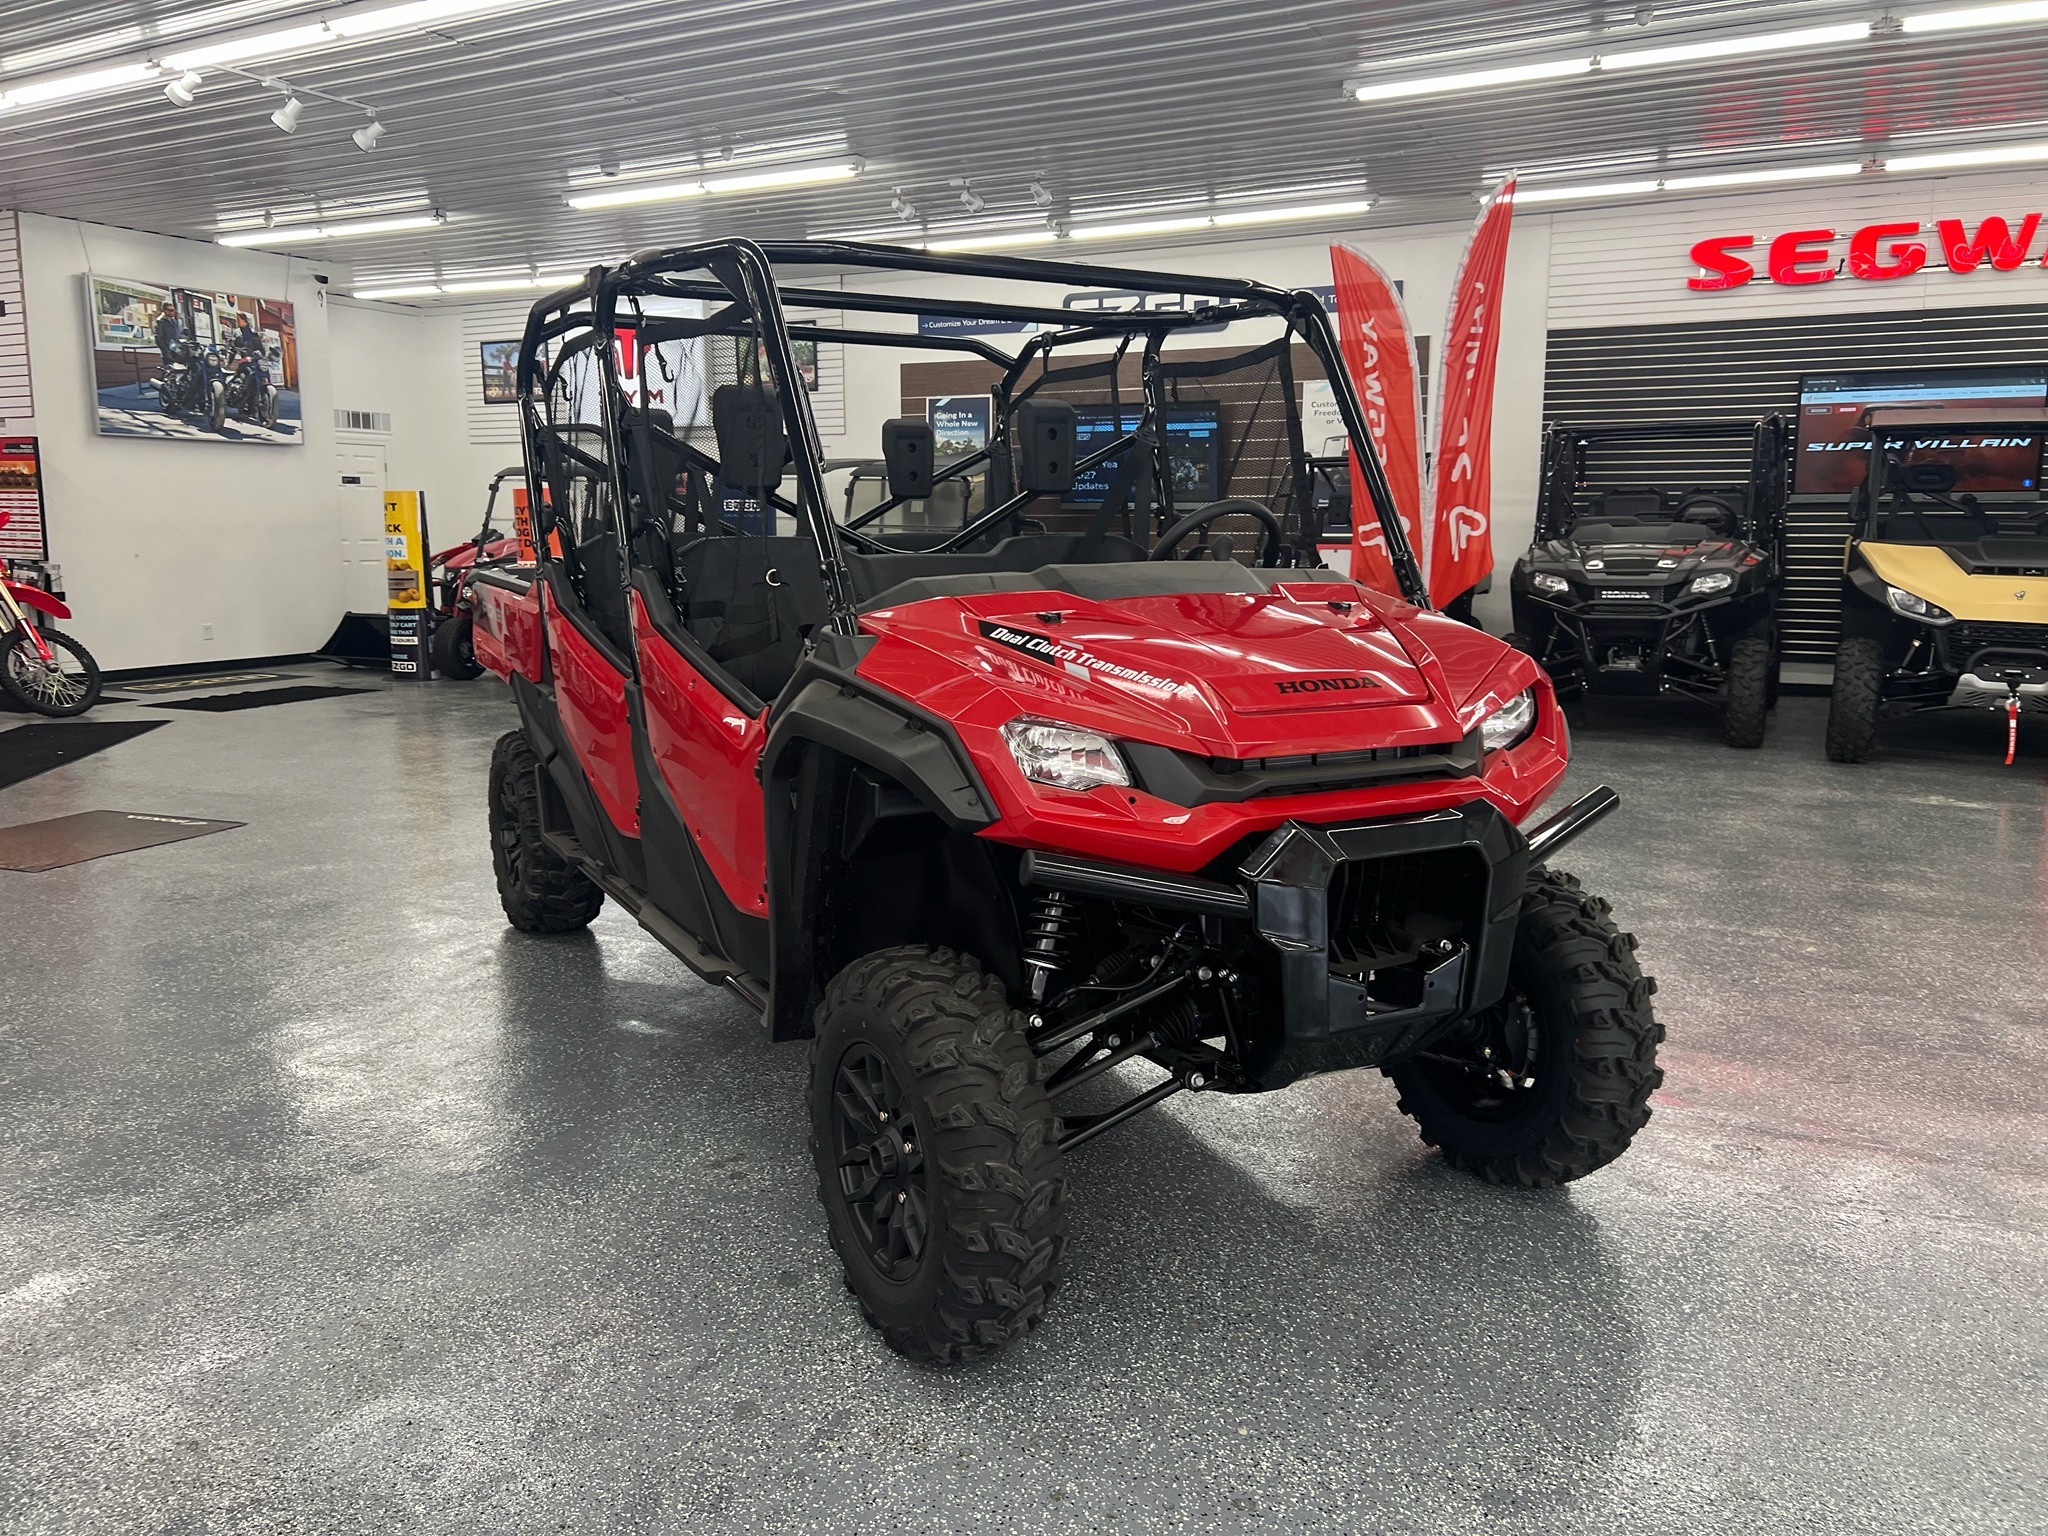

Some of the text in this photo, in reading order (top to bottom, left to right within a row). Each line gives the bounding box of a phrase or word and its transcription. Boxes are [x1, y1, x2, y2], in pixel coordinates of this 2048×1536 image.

[1687, 212, 2048, 290] SEGW
[928, 320, 961, 329] Customize
[936, 411, 957, 419] Going
[936, 420, 960, 428] Whole
[1914, 438, 2032, 449] VILLAIN
[386, 524, 402, 532] CK
[989, 627, 1188, 696] Dual Clutch Transmission
[1274, 676, 1382, 694] HONDA
